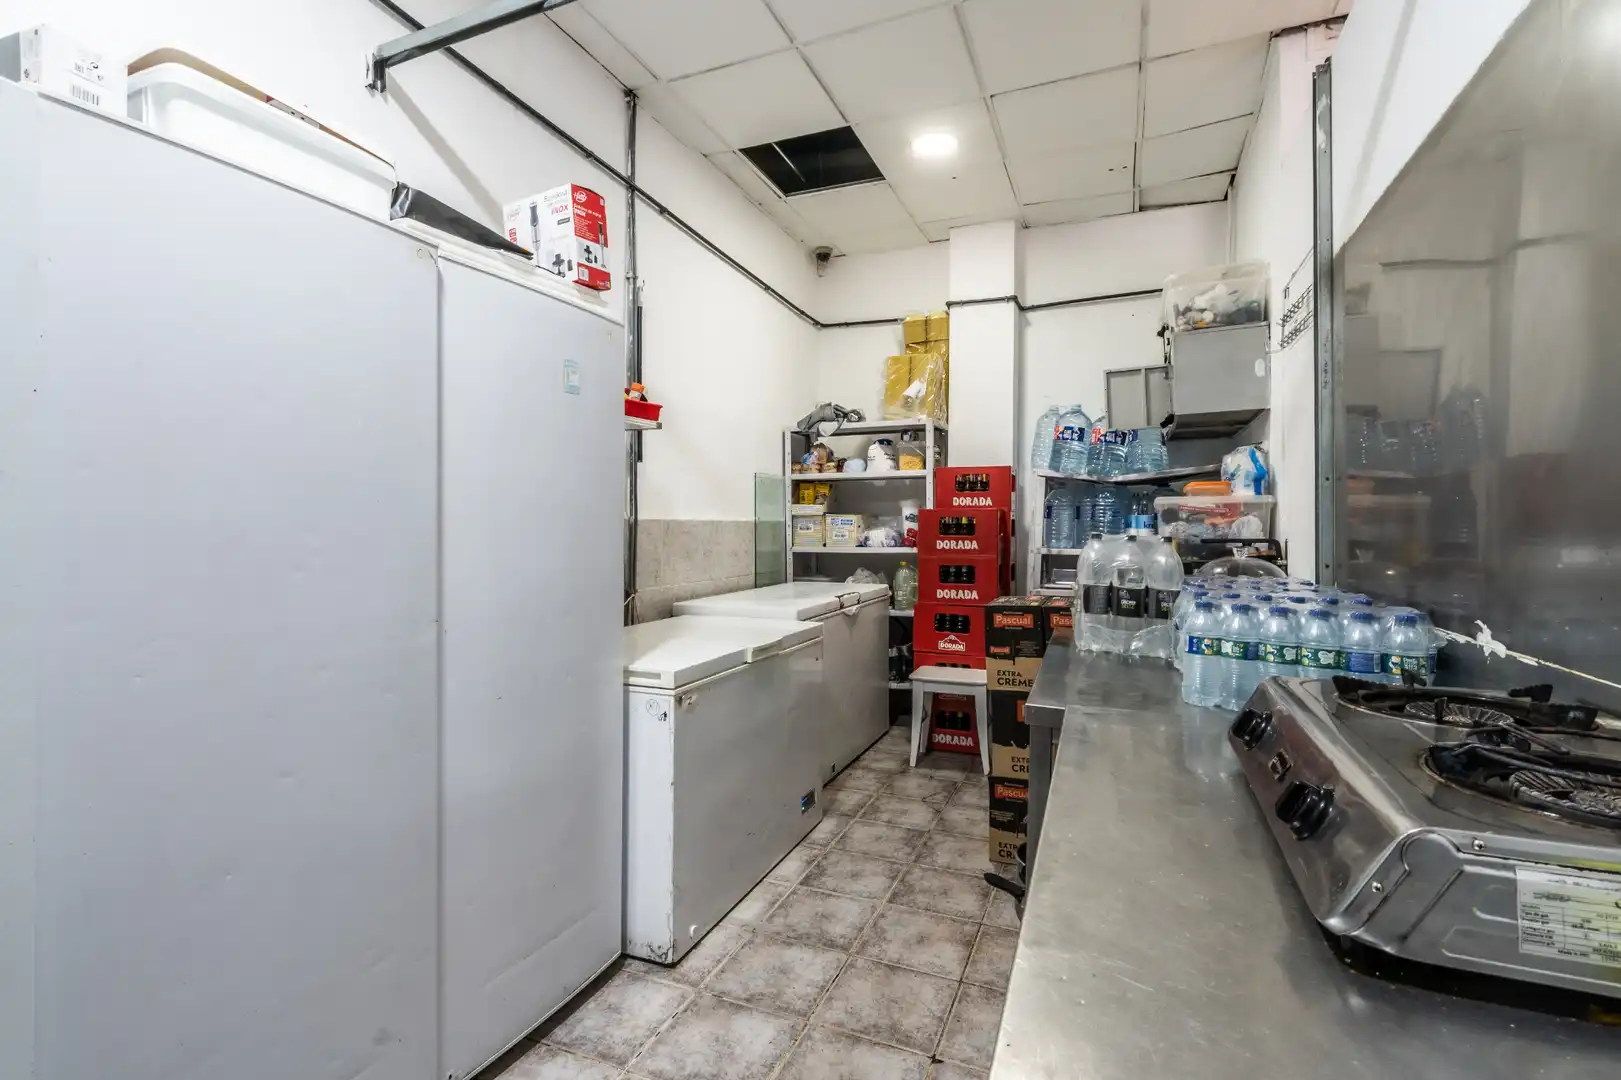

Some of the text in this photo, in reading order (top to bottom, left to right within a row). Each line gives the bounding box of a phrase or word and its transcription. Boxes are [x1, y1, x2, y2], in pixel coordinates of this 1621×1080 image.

[952, 497, 992, 506] DORADA
[936, 540, 978, 549] DORADA
[936, 589, 978, 599] DORADA
[995, 615, 1031, 625] Pascual
[1053, 616, 1073, 625] Pasc
[940, 642, 964, 650] DORADA
[997, 669, 1022, 677] EXTRA
[932, 733, 974, 746] DORADA
[998, 787, 1026, 797] Pascu
[999, 842, 1017, 850] EXTR
